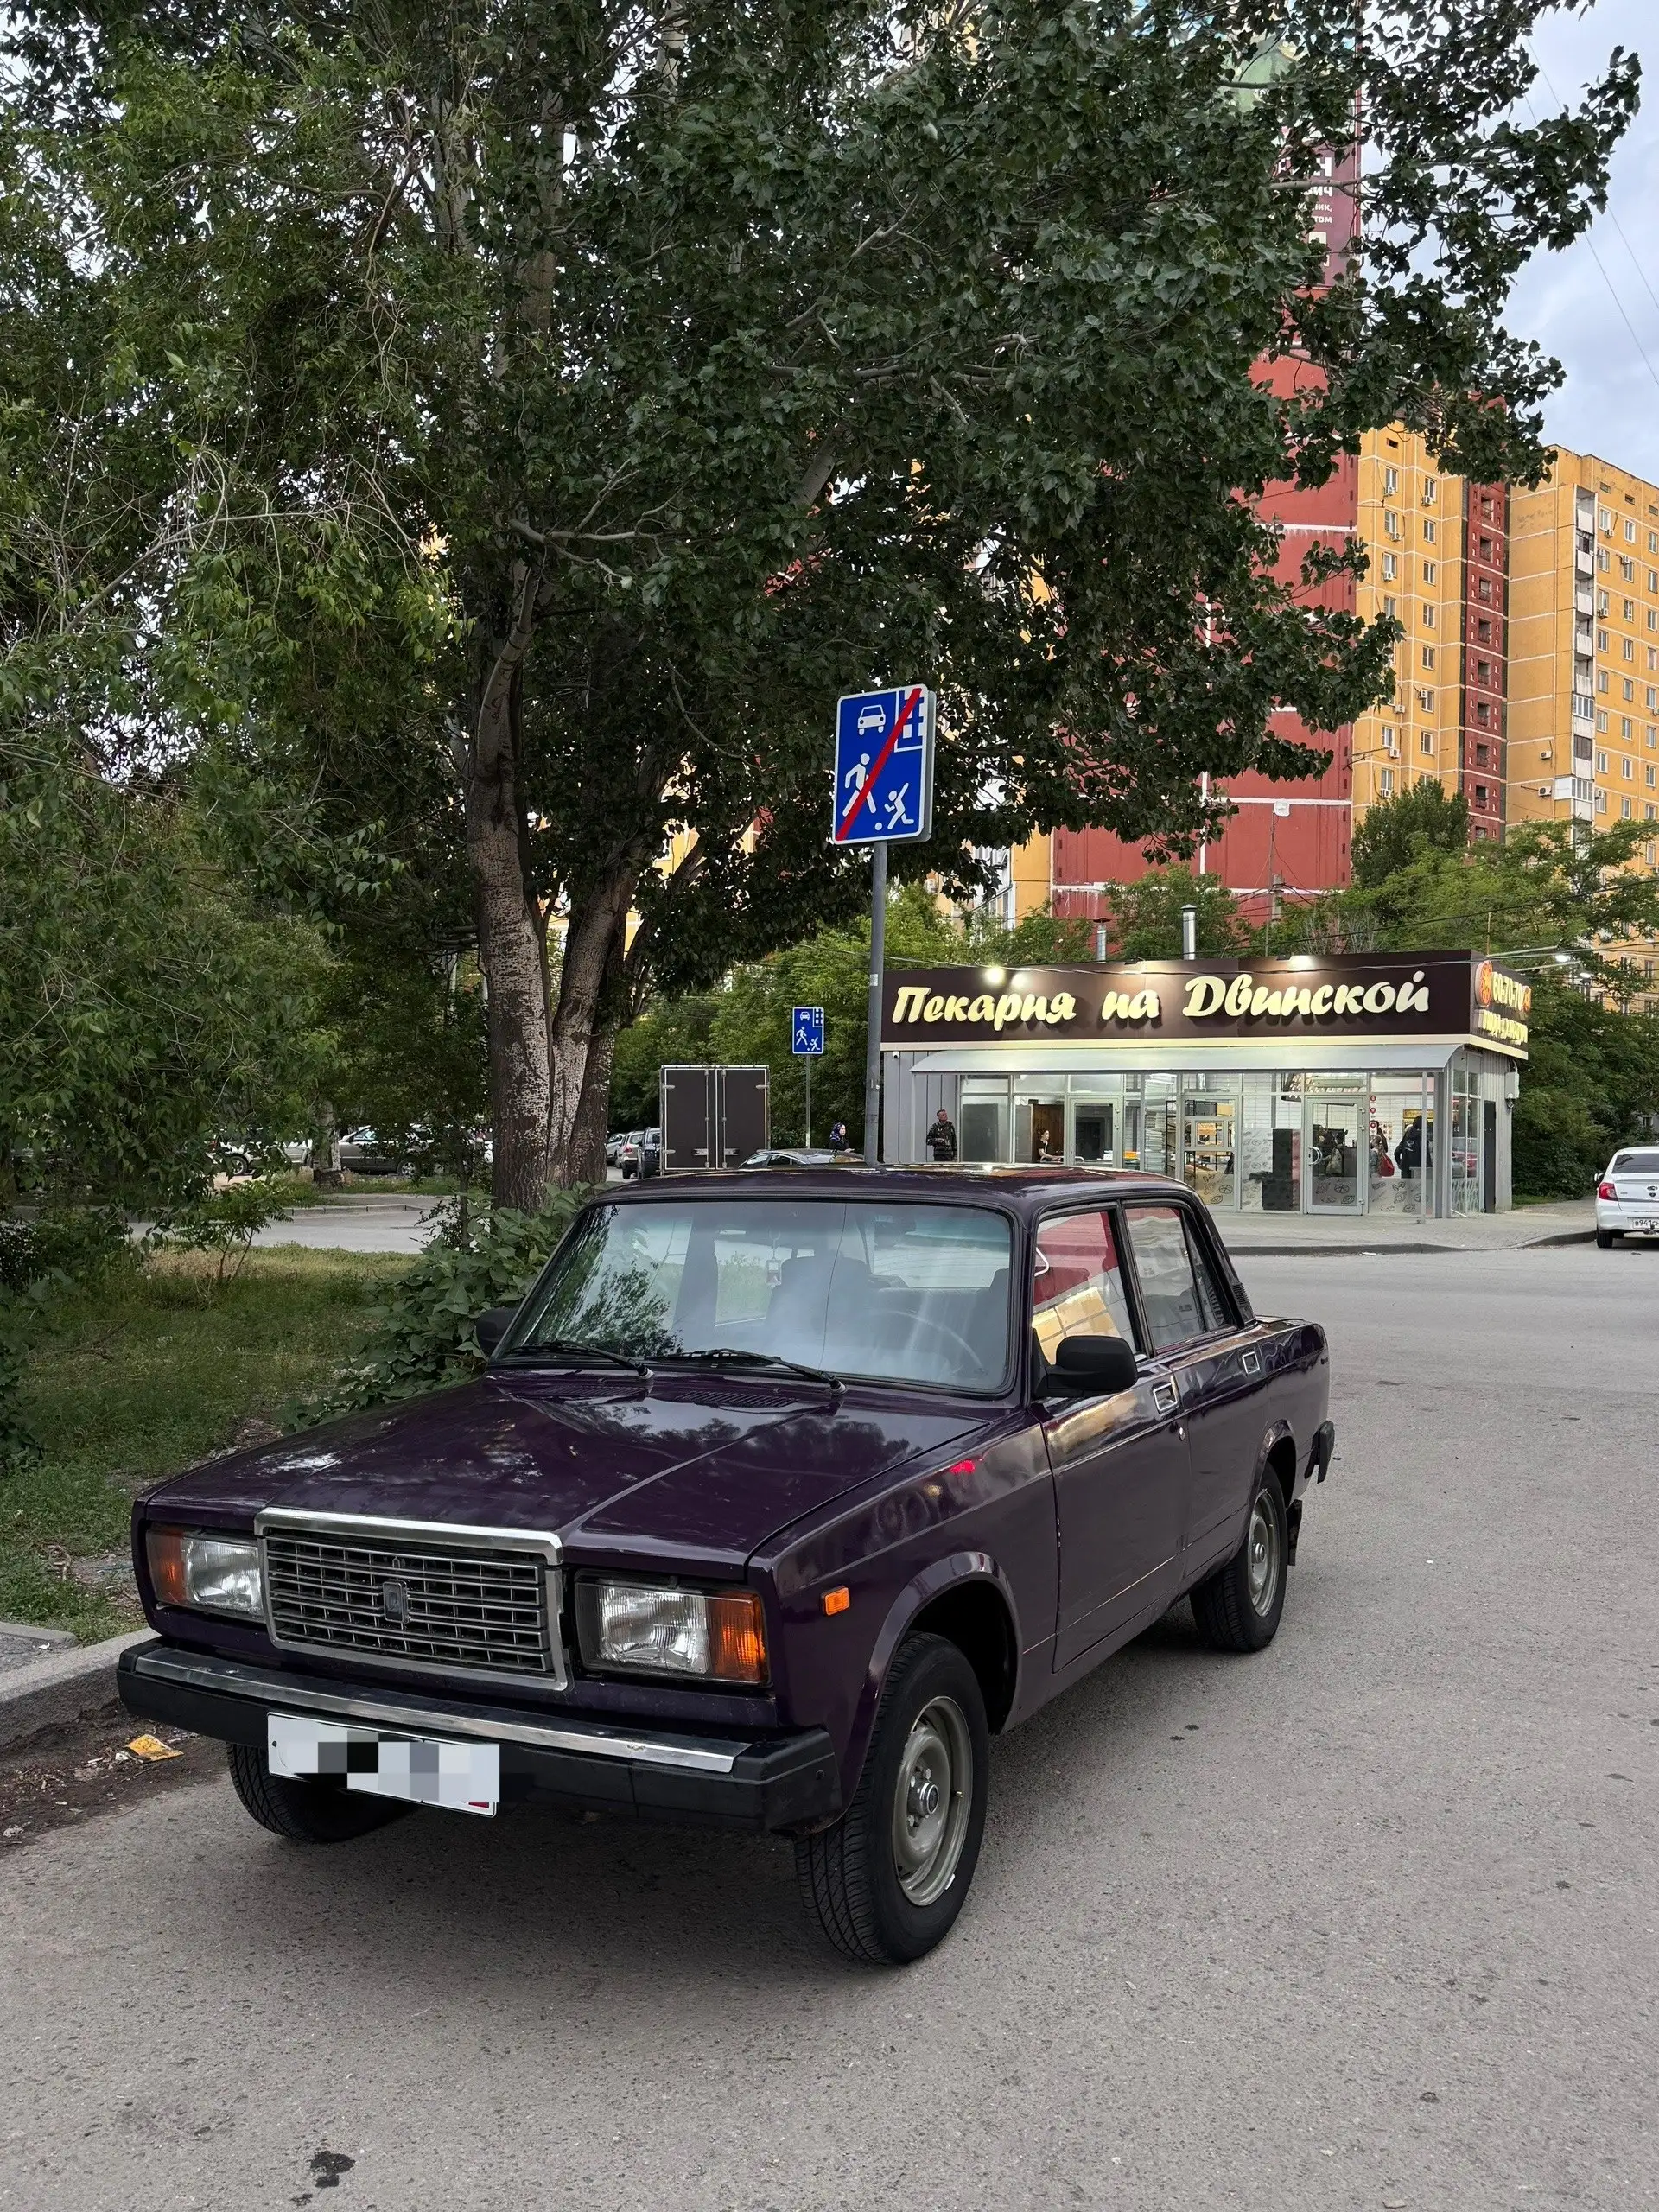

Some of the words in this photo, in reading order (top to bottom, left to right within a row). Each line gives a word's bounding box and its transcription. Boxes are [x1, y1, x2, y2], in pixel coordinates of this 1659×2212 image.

[892, 986, 1077, 1031] Пекарня
[1102, 989, 1160, 1020] на
[1182, 970, 1429, 1017] Двинской
